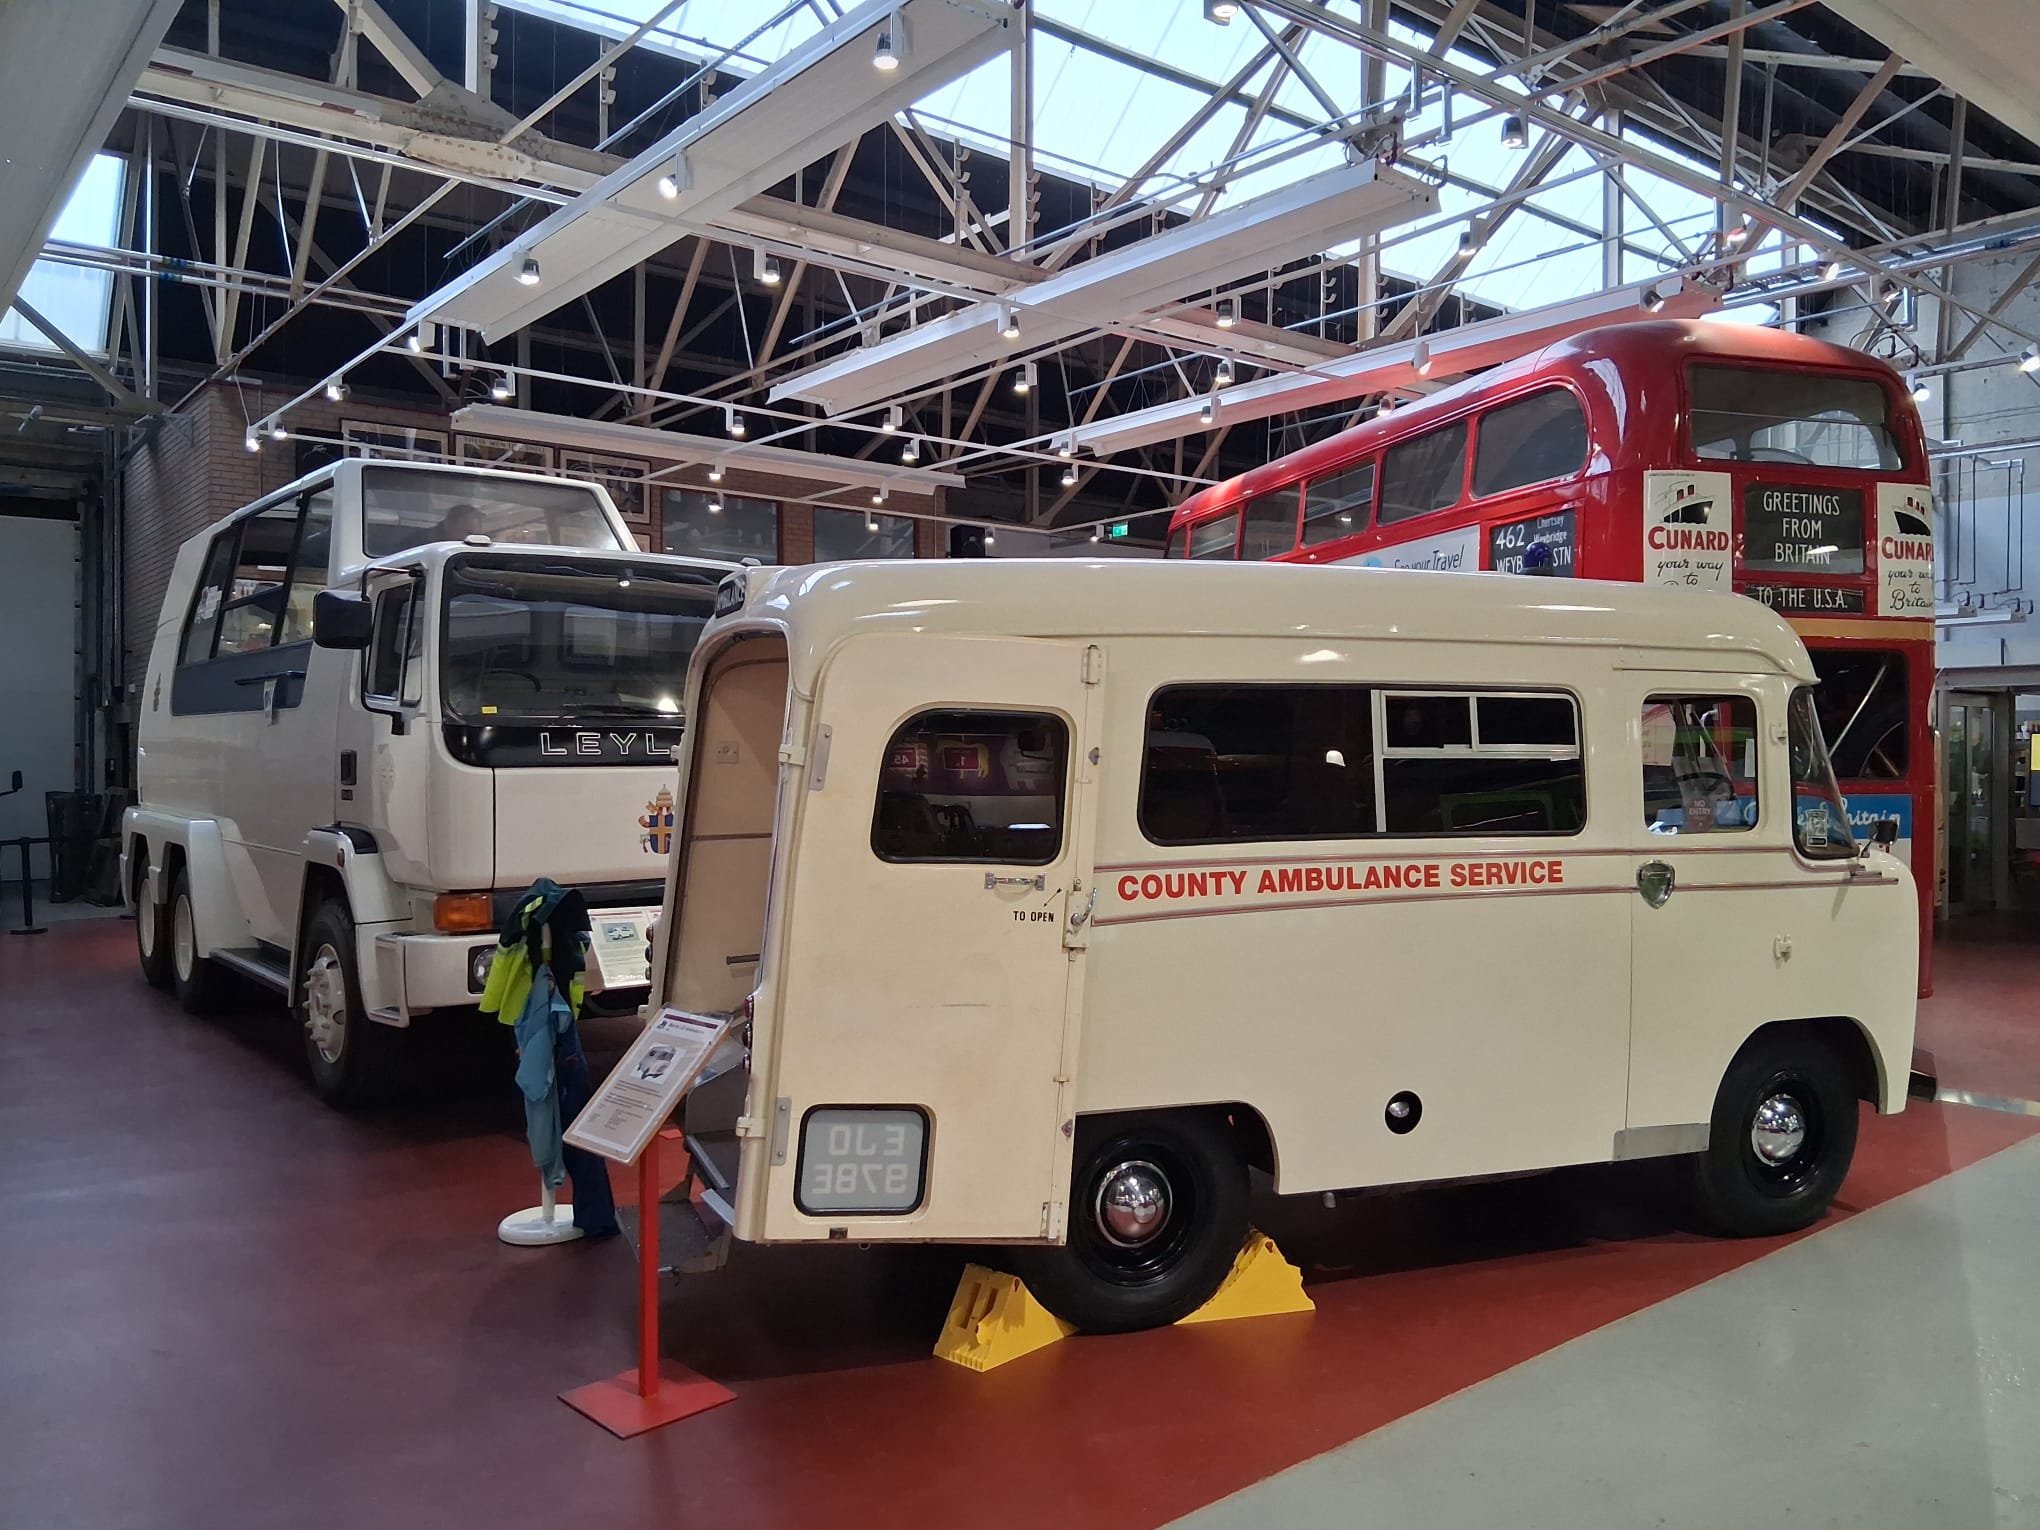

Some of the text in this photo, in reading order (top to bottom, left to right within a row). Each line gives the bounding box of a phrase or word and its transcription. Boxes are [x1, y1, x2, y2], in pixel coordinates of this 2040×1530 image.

[1763, 491, 1840, 516] GREETINGS
[1495, 524, 1525, 550] 462
[1648, 526, 1729, 551] CUNARD
[1782, 518, 1822, 539] FROM
[1432, 544, 1465, 571] Travel
[1552, 546, 1572, 567] STN
[1775, 543, 1830, 565] BRITAIN
[1657, 559, 1724, 582] your way
[1683, 572, 1699, 586] to
[1888, 569, 1913, 586] your
[1756, 587, 1848, 609] TO THE U.S.A.
[1908, 581, 1921, 594] to
[540, 732, 670, 755] LEYL
[1688, 807, 1711, 816] ENTRY
[1694, 799, 1706, 808] NO
[1118, 860, 1563, 901] COUNTY AMBULANCE SERVICE
[1013, 910, 1054, 923] TO OPEN
